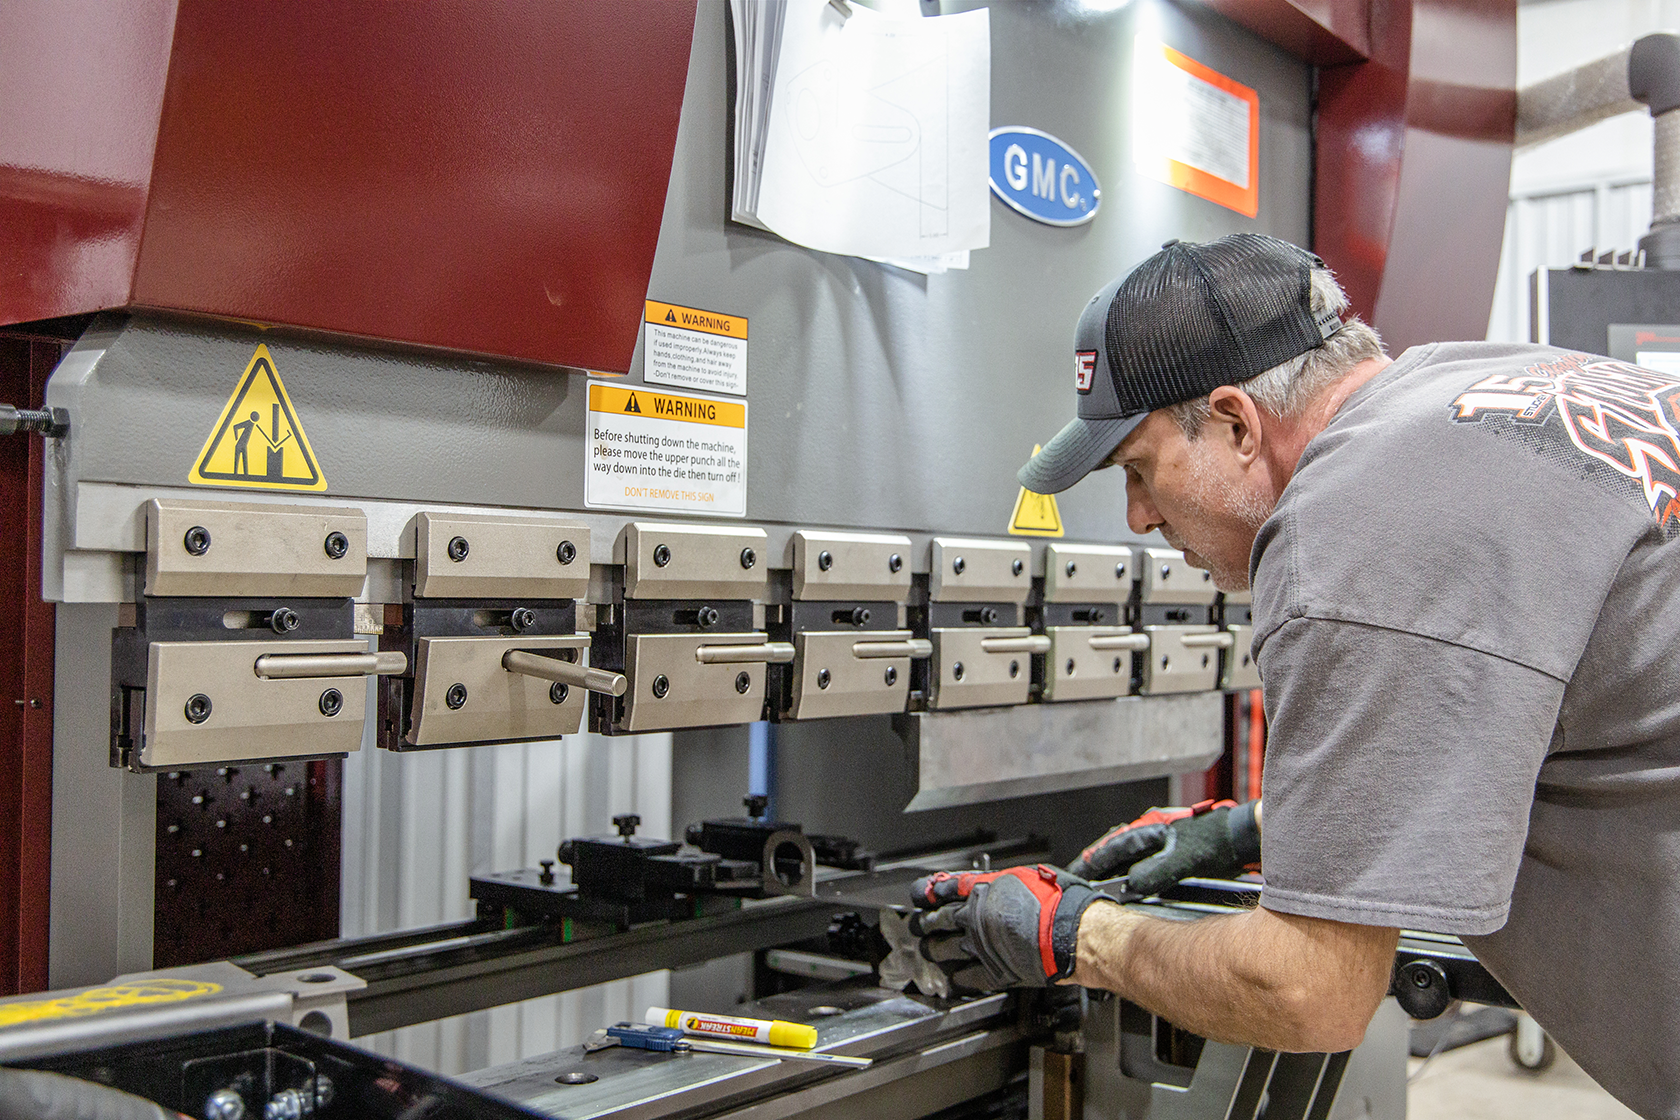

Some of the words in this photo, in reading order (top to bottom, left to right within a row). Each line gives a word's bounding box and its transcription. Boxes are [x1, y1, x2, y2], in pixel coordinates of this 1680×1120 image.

[1004, 143, 1080, 209] GMC
[682, 312, 730, 332] WARNING
[654, 329, 666, 337] This
[667, 332, 690, 342] machine
[710, 339, 738, 351] dangerous
[658, 341, 673, 349] used
[723, 350, 736, 360] keep
[653, 359, 667, 368] from
[667, 361, 676, 369] the
[677, 363, 700, 373] machine
[707, 369, 722, 377] avoid
[707, 358, 717, 366] hair
[718, 361, 732, 369] away
[671, 373, 692, 382] remove
[699, 377, 715, 385] cover
[715, 379, 725, 387] this
[654, 397, 716, 420] WARNING
[594, 428, 623, 443] Before
[624, 431, 660, 449] shutting
[661, 435, 685, 449] down
[686, 438, 700, 450] the
[701, 441, 737, 455] machine,
[593, 444, 622, 458] please
[623, 451, 648, 461] move
[649, 449, 663, 461] the
[664, 453, 689, 466] upper
[690, 455, 716, 467] punch
[716, 456, 726, 467] all
[727, 458, 741, 469] the
[593, 462, 612, 476] way
[613, 461, 638, 475] down
[639, 464, 657, 476] into
[658, 465, 672, 478] the
[673, 467, 686, 479] die
[687, 468, 706, 480] then
[707, 471, 725, 481] turn
[624, 486, 648, 498] DON'T
[649, 488, 680, 500] REMOVE
[680, 490, 697, 502] THIS
[697, 492, 715, 503] SIGN
